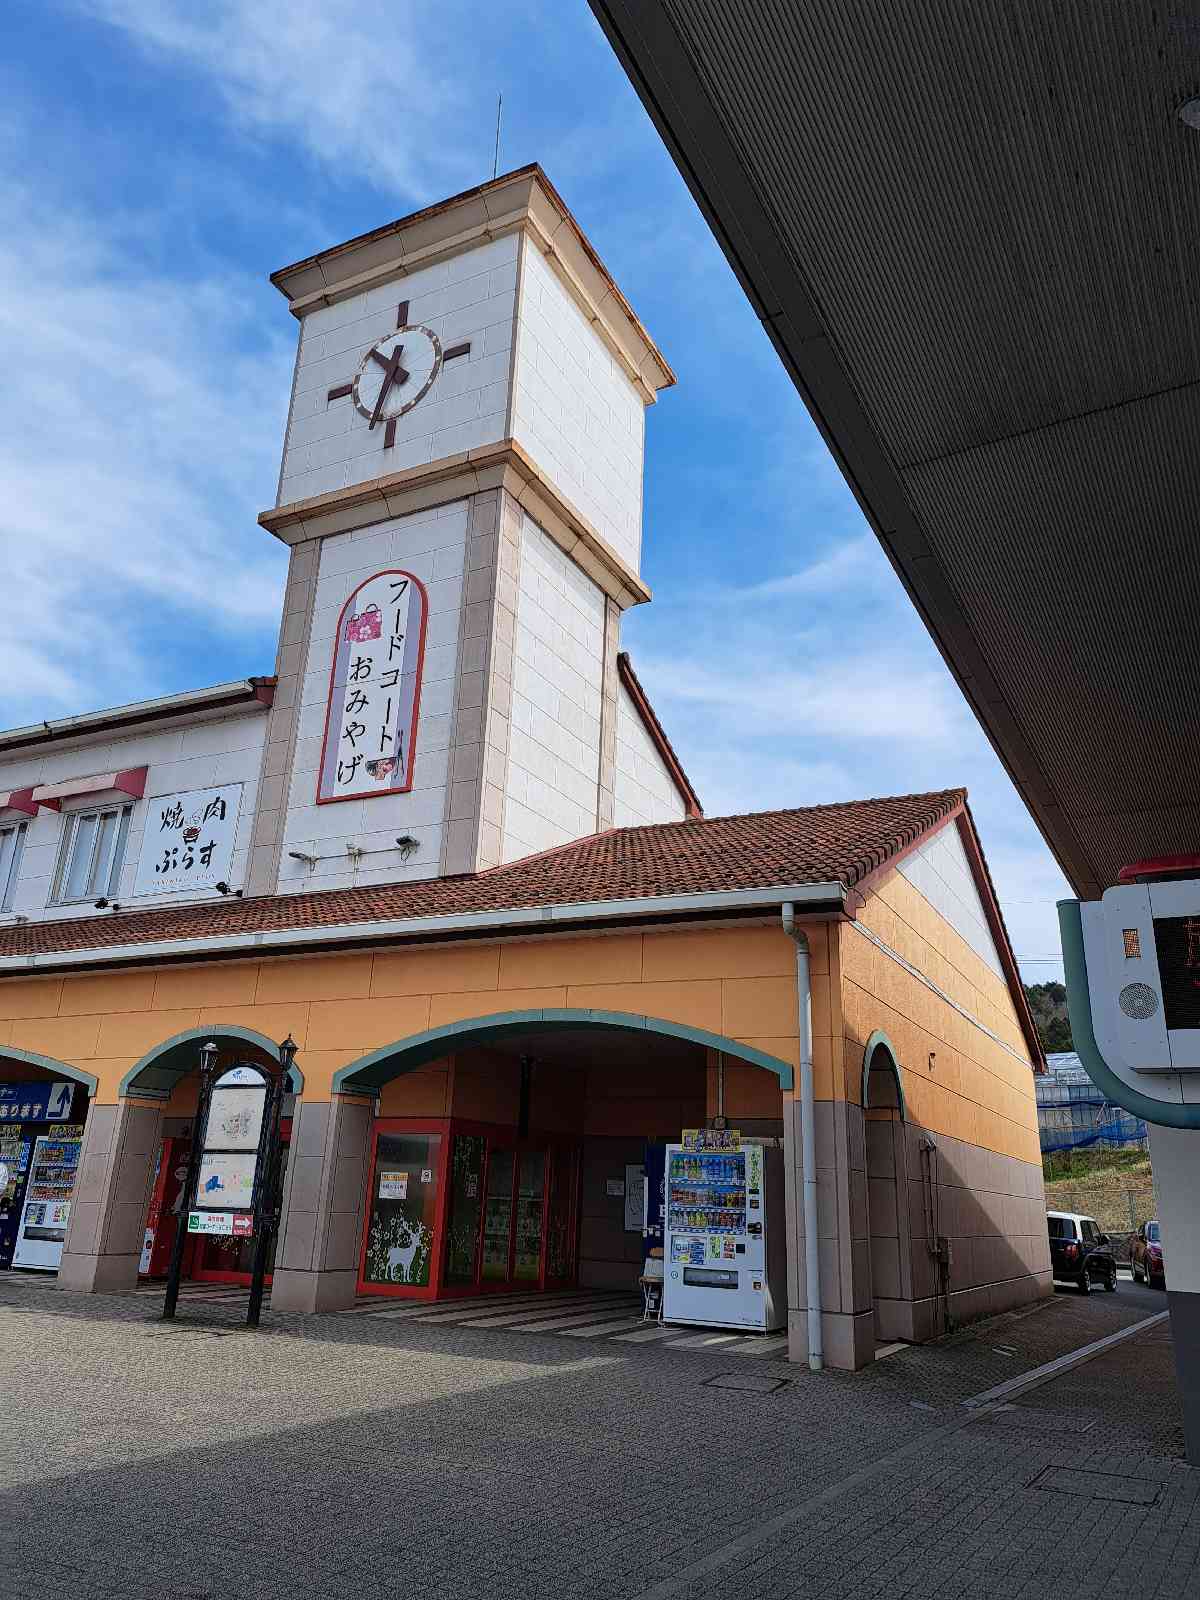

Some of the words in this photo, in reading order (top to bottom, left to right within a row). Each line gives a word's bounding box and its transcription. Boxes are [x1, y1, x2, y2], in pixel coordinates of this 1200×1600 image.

[380, 580, 408, 752] フードコート
[337, 656, 373, 785] おみやげ
[160, 796, 226, 832] 焼肉
[155, 840, 216, 873] ぷらす
